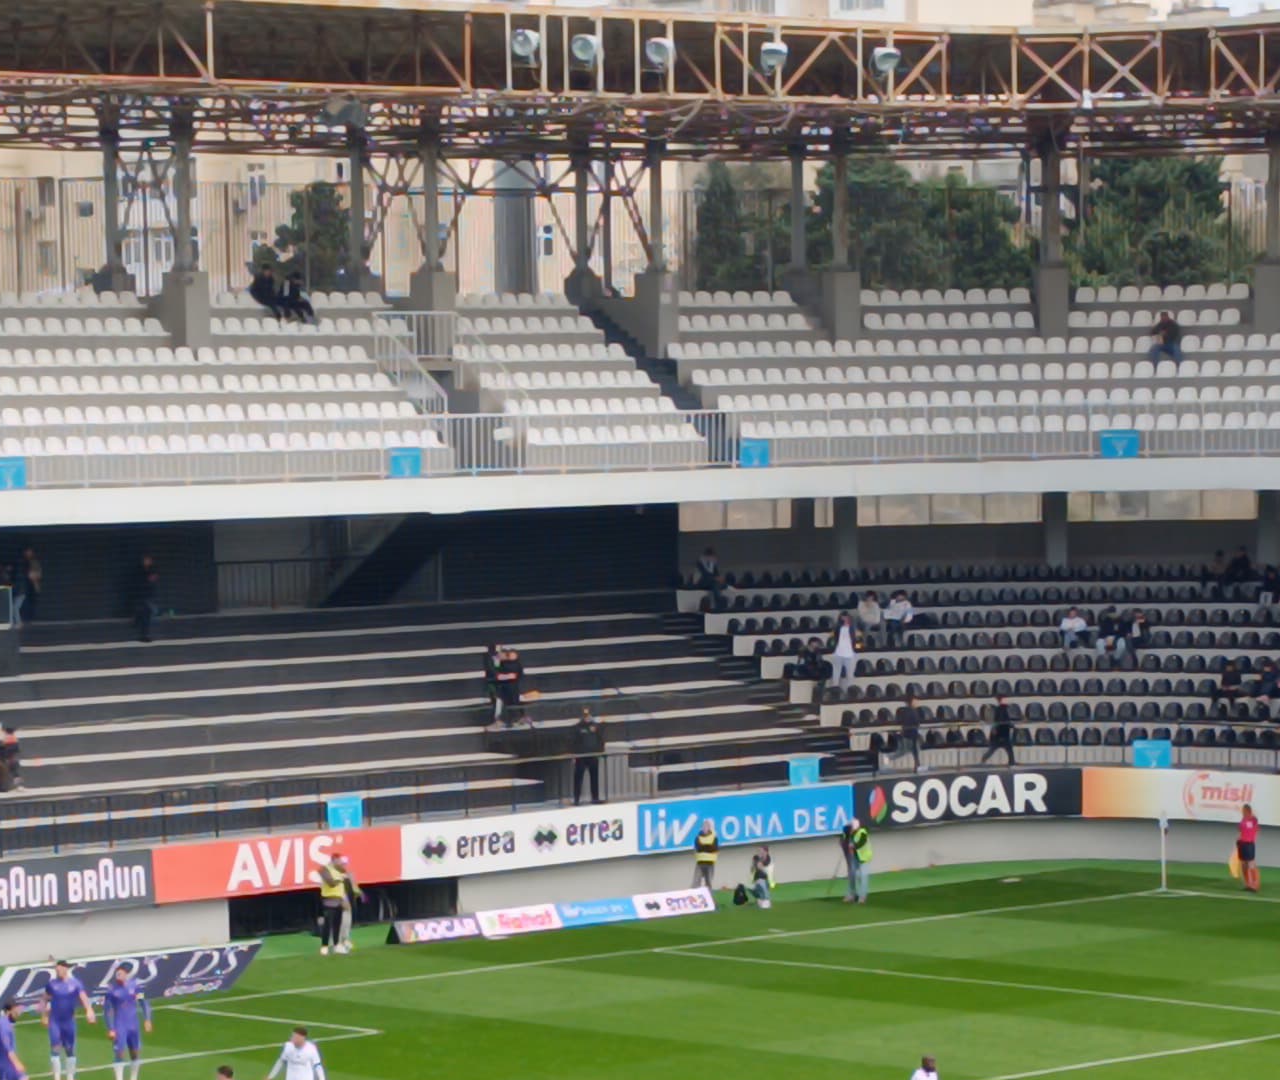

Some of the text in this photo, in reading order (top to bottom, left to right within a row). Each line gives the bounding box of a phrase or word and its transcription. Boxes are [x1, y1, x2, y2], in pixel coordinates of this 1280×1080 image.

[891, 773, 1048, 823] SOCAR
[1201, 783, 1253, 803] misli
[456, 818, 624, 860] errea errea
[793, 805, 848, 834] DEA
[67, 857, 147, 904] BRAUN
[226, 834, 335, 892] AVIS
